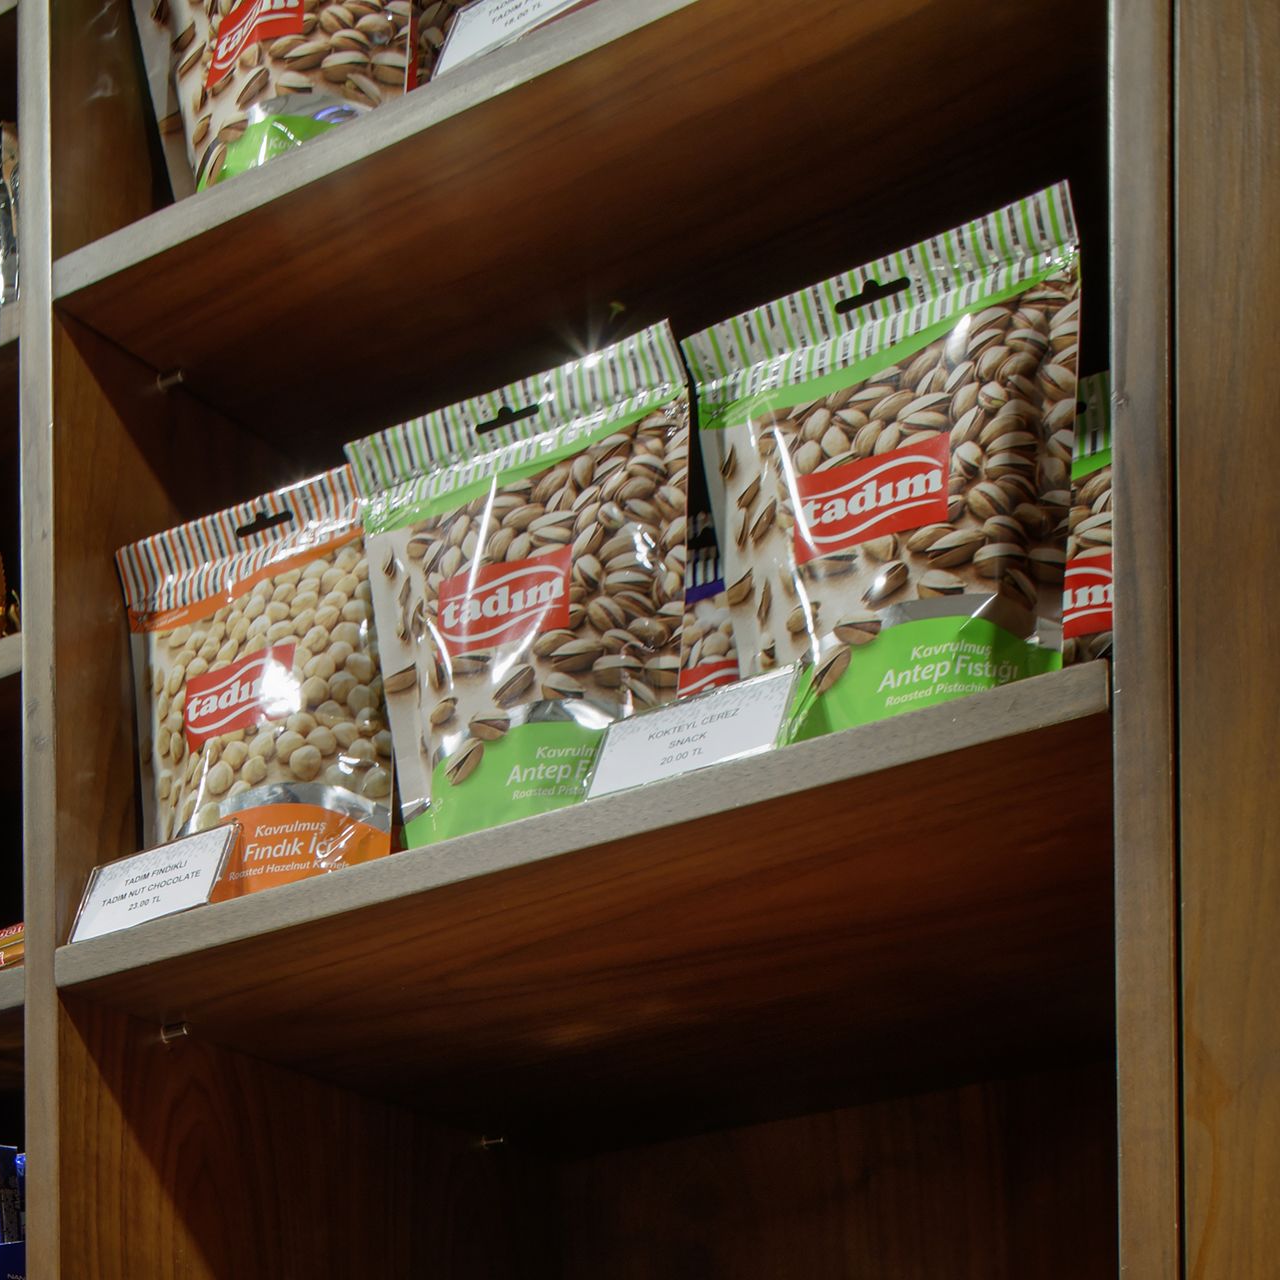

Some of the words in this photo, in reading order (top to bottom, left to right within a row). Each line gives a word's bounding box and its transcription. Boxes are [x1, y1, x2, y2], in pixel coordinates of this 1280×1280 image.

[803, 463, 943, 525] tadım
[441, 574, 565, 629] tadım
[911, 641, 992, 661] Kavrulmuş
[878, 660, 951, 695] Antep
[954, 654, 1019, 679] Fıstığı
[668, 732, 707, 749] SNACK
[506, 760, 571, 786] Antep
[255, 818, 327, 837] Kavrulmuş
[124, 872, 150, 887] TADIM
[152, 860, 187, 880] FINDIKLI
[102, 894, 127, 907] TADIM
[129, 889, 147, 899] NUT
[149, 868, 201, 893] CHOCOLATE
[128, 900, 149, 911] 23.00
[151, 894, 161, 905] TL
